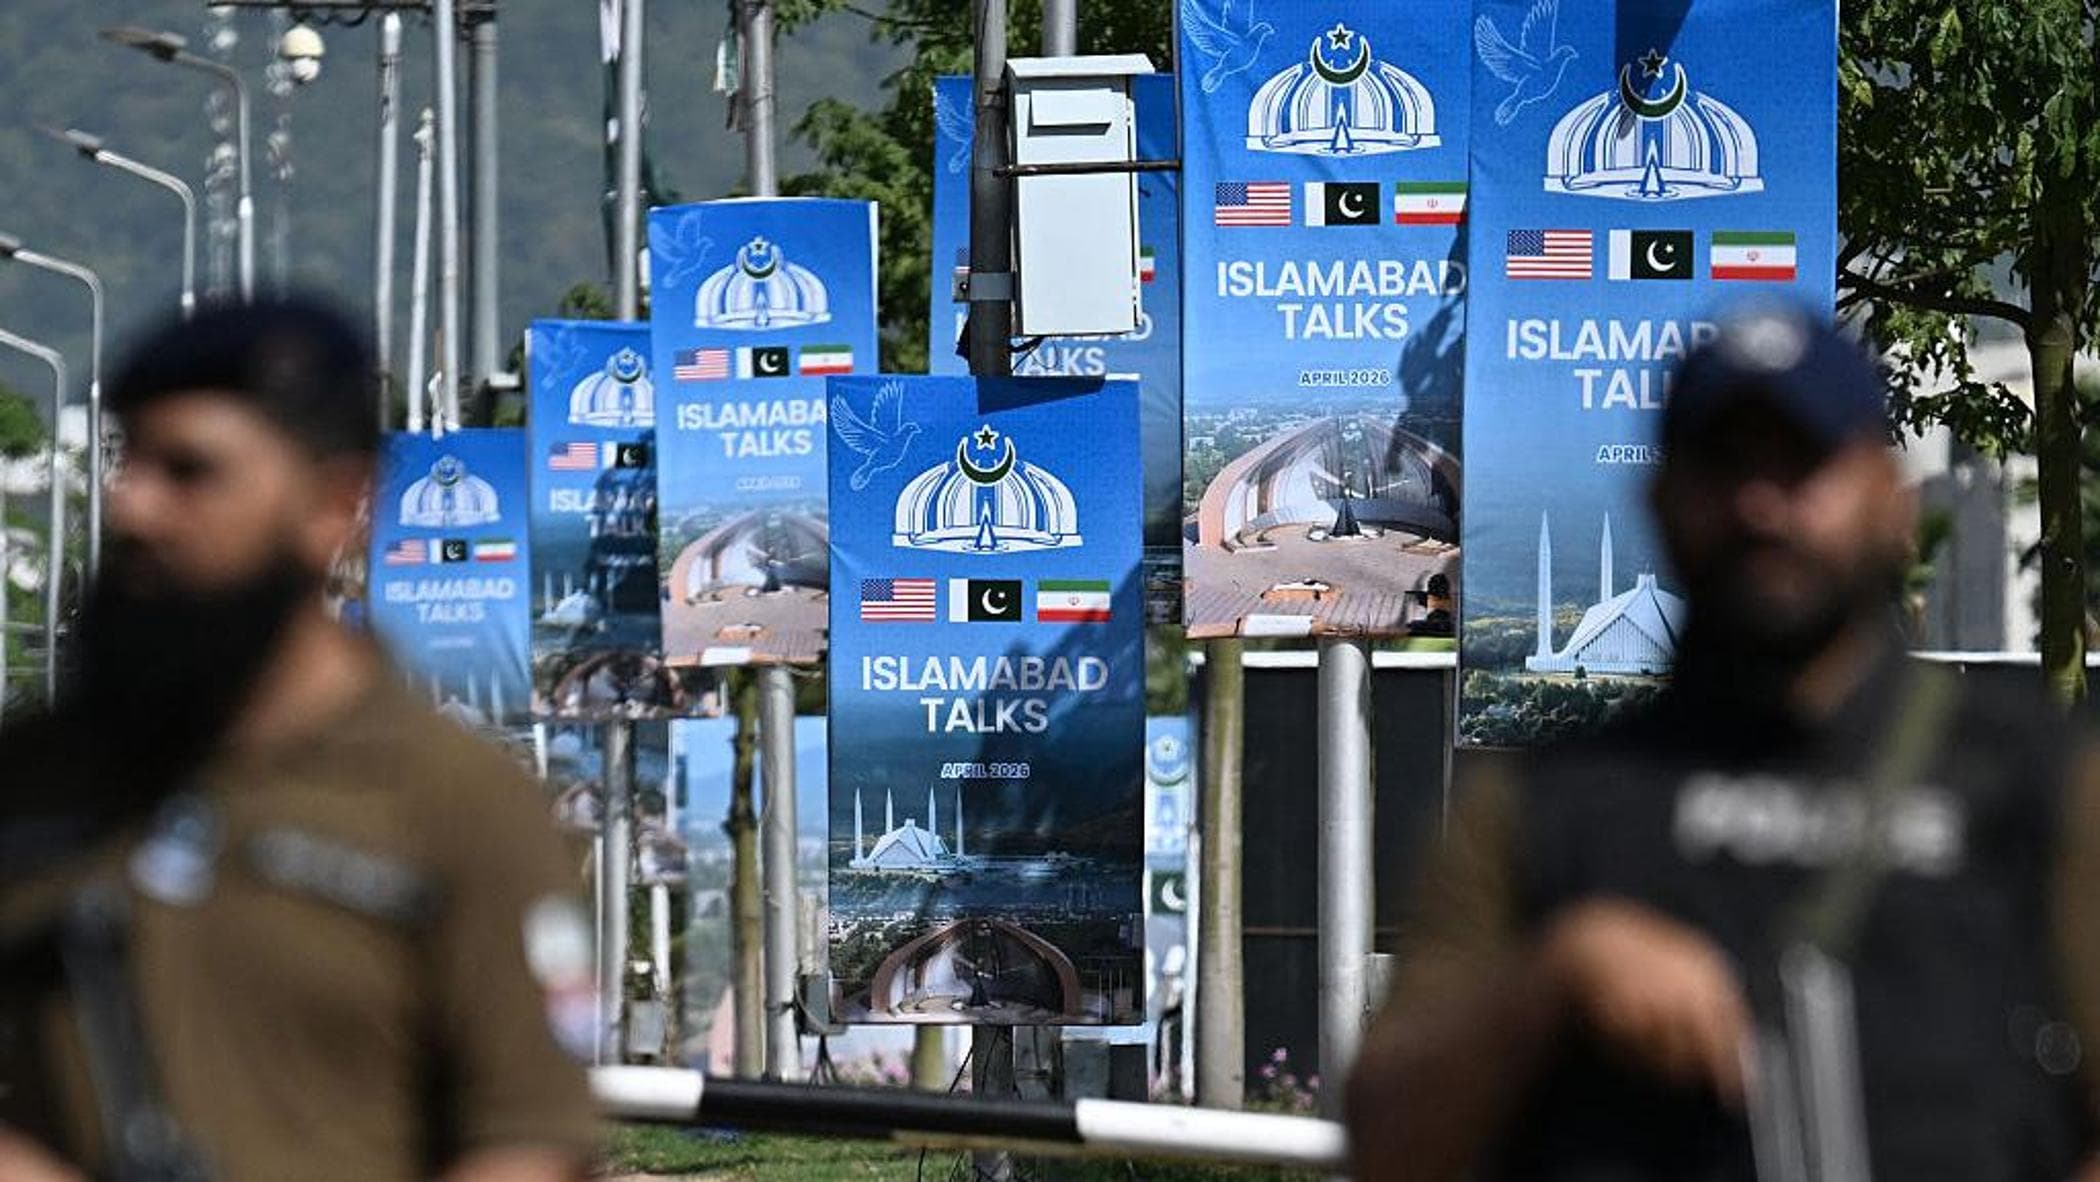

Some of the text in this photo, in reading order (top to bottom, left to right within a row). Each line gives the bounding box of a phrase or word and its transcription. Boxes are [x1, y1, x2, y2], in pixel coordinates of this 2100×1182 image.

[1217, 260, 1467, 297] ISLAMABAD
[1276, 302, 1408, 340] TALKS
[1011, 347, 1106, 376] ALKS
[1299, 368, 1391, 386] APRIL 2026
[1573, 368, 1672, 410] TAL
[677, 400, 826, 430] ISLAMABA
[719, 430, 812, 458] TALKS
[1597, 445, 1649, 463] APRIL
[862, 656, 1109, 691] ISLAMABAD
[919, 697, 1048, 733] TALKS
[941, 763, 1030, 779] APRIL 2026
